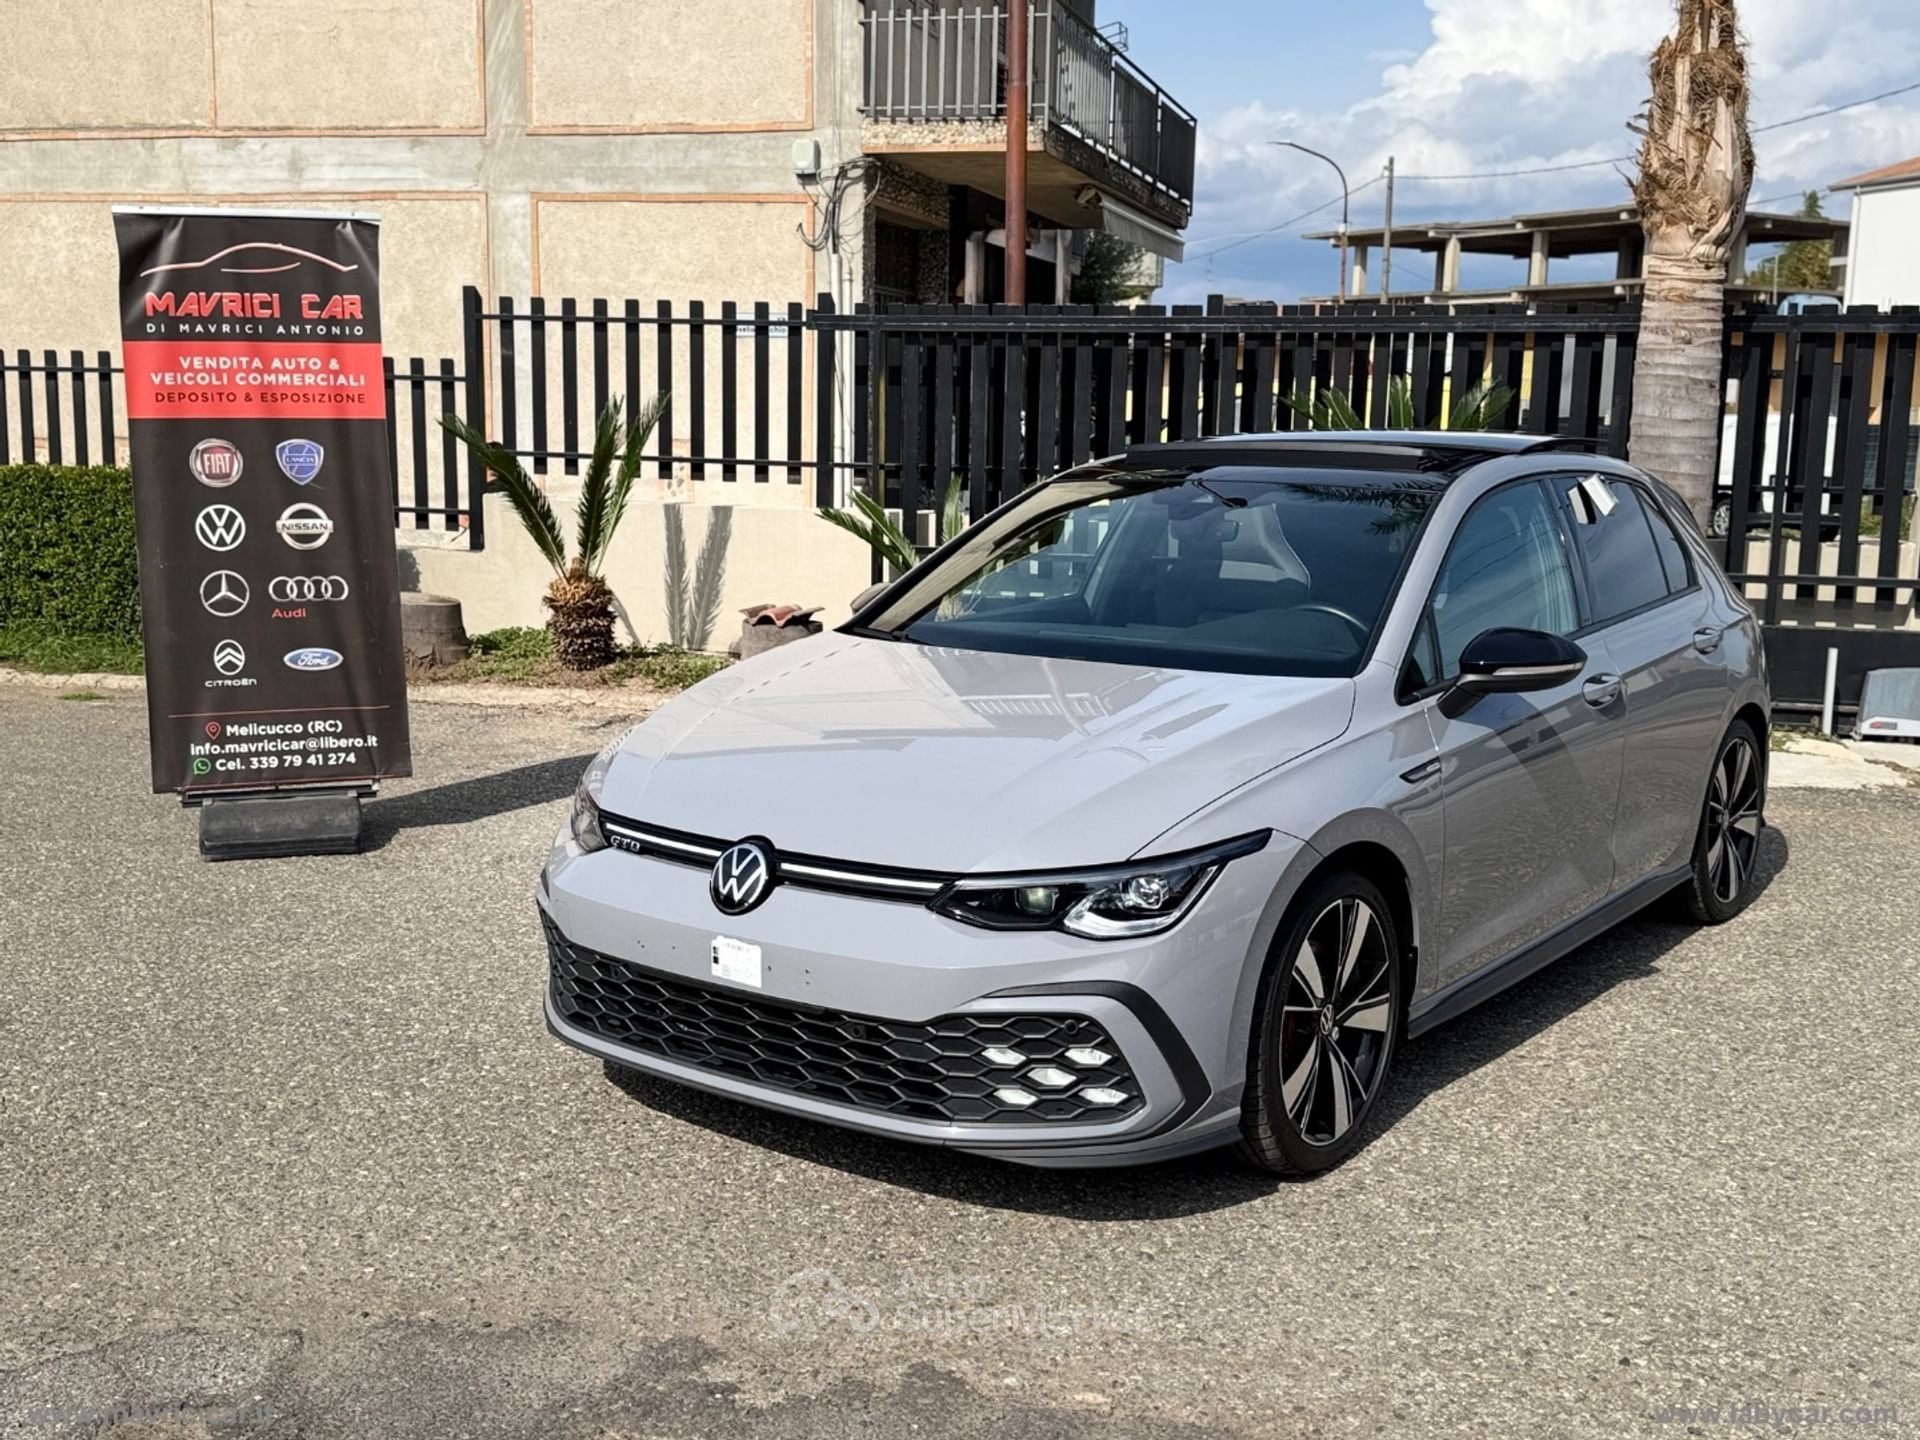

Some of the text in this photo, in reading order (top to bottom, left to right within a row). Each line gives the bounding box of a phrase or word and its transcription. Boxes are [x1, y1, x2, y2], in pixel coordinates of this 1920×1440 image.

[145, 291, 363, 320] MAVRICI CAR
[146, 323, 364, 336] DI MAVRICI ANTONIO
[179, 356, 340, 370] VENDITA AUTO &
[150, 372, 365, 386] VEICOLI COMMERCIALI
[155, 391, 365, 404] DEPOSITO & ESPOSIZIONE
[203, 453, 232, 475] FIAT
[281, 521, 329, 531] NISSAN
[271, 607, 306, 618] Audi
[297, 652, 330, 668] Ford
[226, 720, 343, 737] Melicucco (RC)
[190, 735, 378, 756] info.mavricicar@libero.it
[215, 752, 356, 771] Cel. 339 79 41 274
[610, 835, 641, 852] GTD
